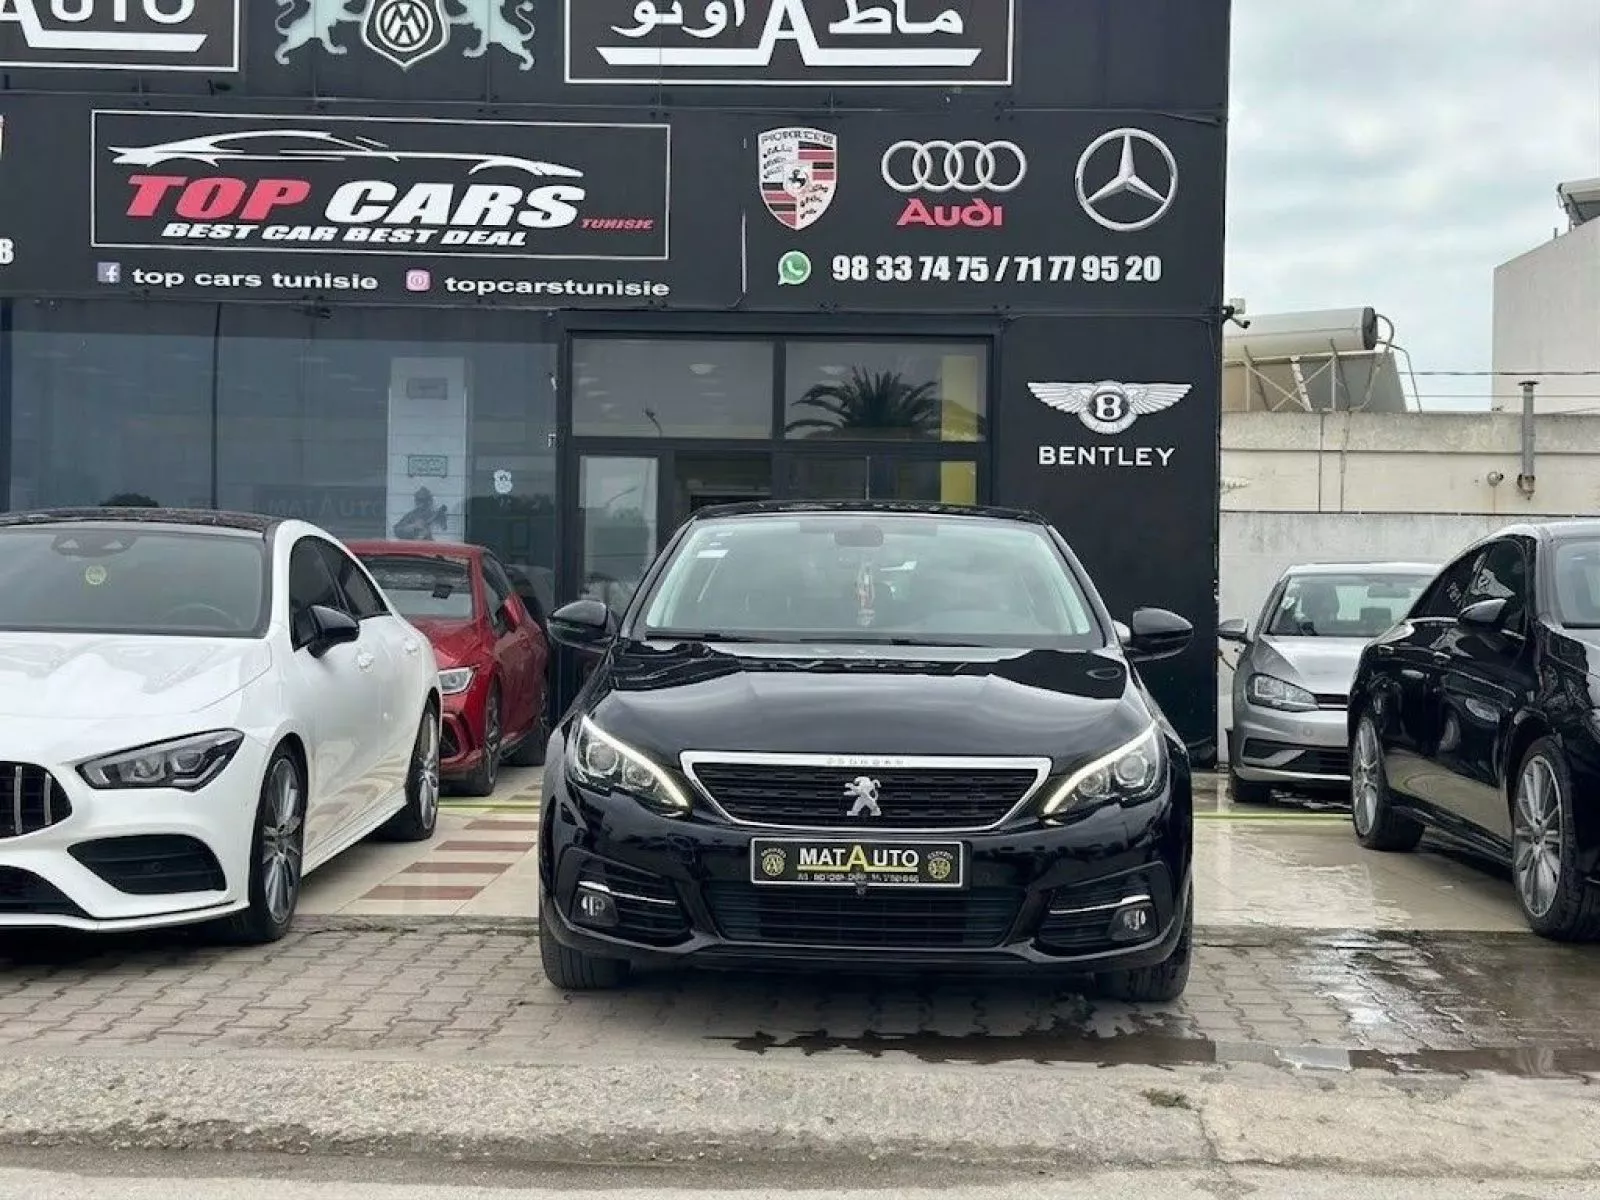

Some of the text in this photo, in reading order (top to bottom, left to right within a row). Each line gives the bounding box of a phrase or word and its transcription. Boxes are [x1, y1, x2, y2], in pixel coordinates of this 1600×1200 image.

[127, 174, 586, 228] TOP CARS
[896, 197, 1004, 227] Audi
[161, 222, 527, 247] BEST CAR BEST DEAL
[132, 268, 379, 290] top cars tunisie
[832, 254, 869, 282] 98
[875, 254, 913, 282] 33
[918, 255, 951, 282] 74
[955, 255, 990, 282] 75
[1013, 255, 1042, 282] 71
[1047, 255, 1077, 282] 77
[1081, 255, 1120, 282] 95
[1124, 255, 1162, 282] 20
[444, 276, 670, 297] topcarstunisie
[1037, 446, 1176, 467] BENTLEY
